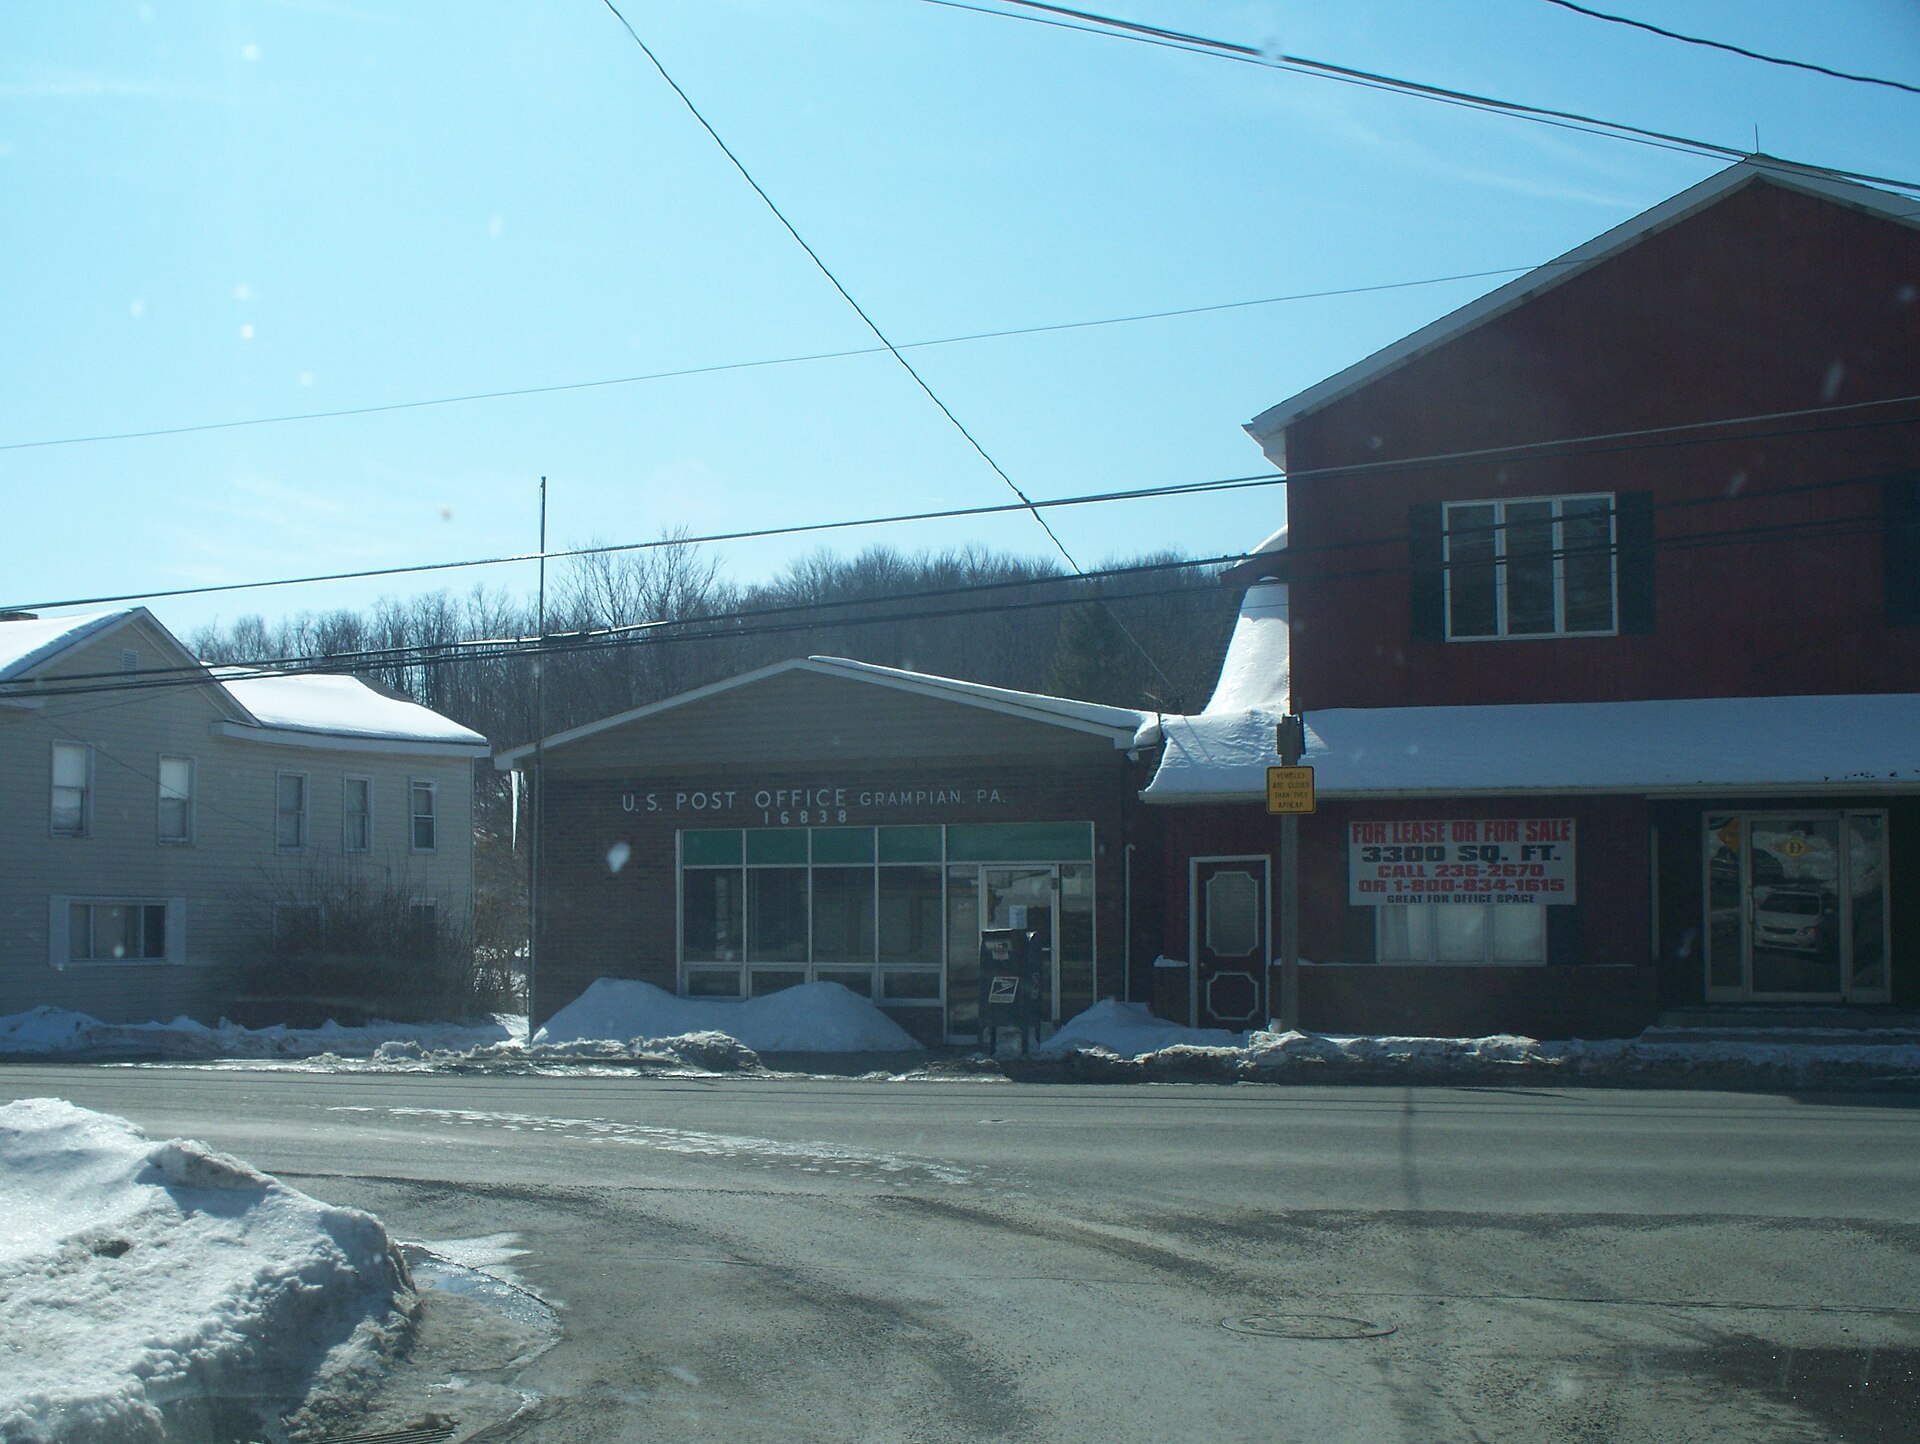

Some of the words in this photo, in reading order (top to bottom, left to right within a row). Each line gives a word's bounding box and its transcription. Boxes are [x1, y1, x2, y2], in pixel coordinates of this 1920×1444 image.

[622, 794, 663, 812] U.S.
[676, 791, 736, 810] POST
[755, 788, 848, 808] OFFICE
[977, 789, 1006, 803] PA.
[763, 810, 848, 824] 16838
[1352, 822, 1386, 843] FOR
[1392, 822, 1445, 843] LEASE
[1452, 821, 1477, 842] OR
[1484, 821, 1519, 842] FOR
[1526, 819, 1571, 842] SALE
[1362, 846, 1446, 863] 3300
[1458, 845, 1509, 864] SQ.
[1521, 845, 1561, 862] FT.
[1377, 865, 1427, 878] CALL
[1434, 864, 1544, 877] 236-2670
[1358, 880, 1387, 893] OR
[1387, 895, 1423, 904] GREAT
[1427, 894, 1450, 904] FOR
[1454, 894, 1492, 904] OFFICE
[1497, 894, 1535, 903] SPACE
